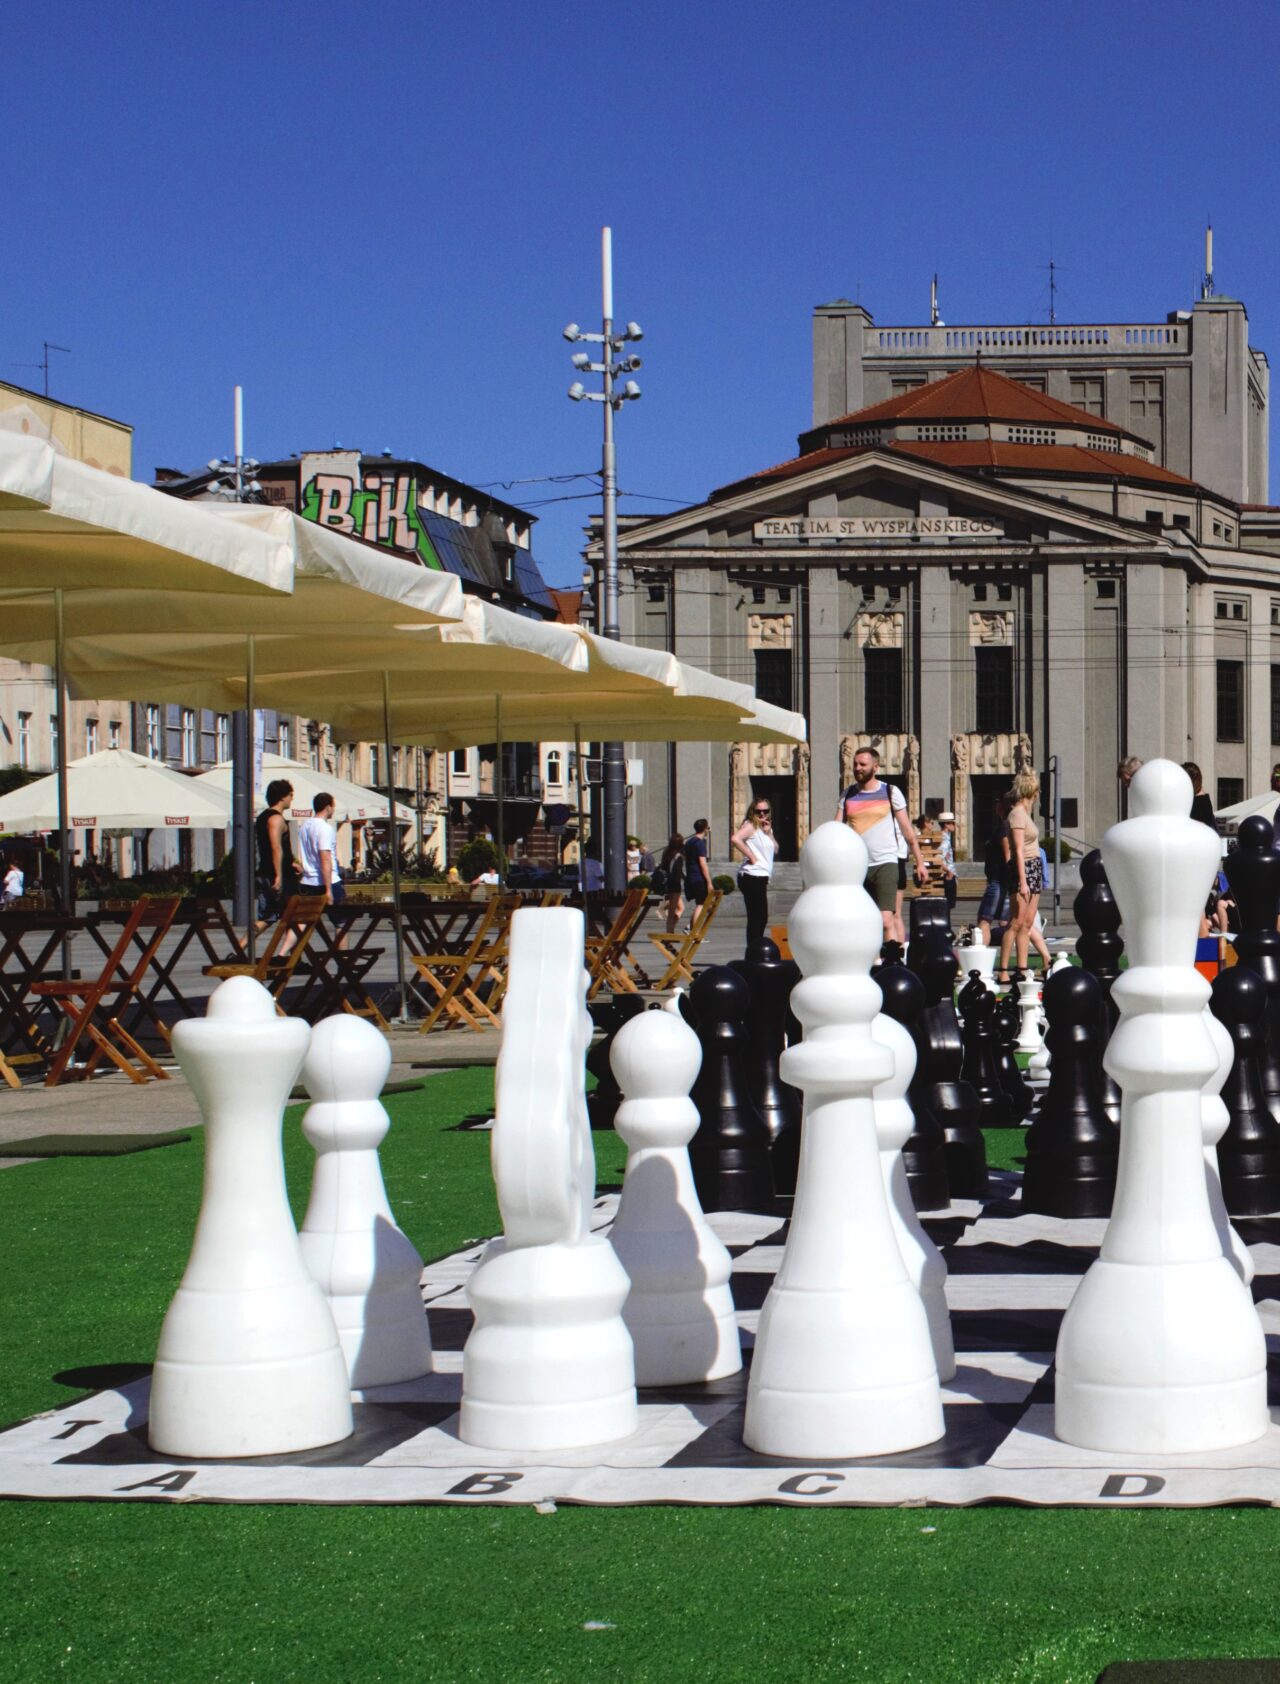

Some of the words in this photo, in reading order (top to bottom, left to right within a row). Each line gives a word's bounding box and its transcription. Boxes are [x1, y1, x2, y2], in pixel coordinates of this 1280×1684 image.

[764, 521, 806, 535] TEATR
[810, 520, 832, 534] IM.
[840, 520, 856, 534] ST.
[862, 518, 994, 534] WYSPIAŃSKIEGO
[112, 1470, 197, 1492] A
[443, 1472, 524, 1496] B
[777, 1472, 846, 1496] C
[1098, 1474, 1167, 1498] D
